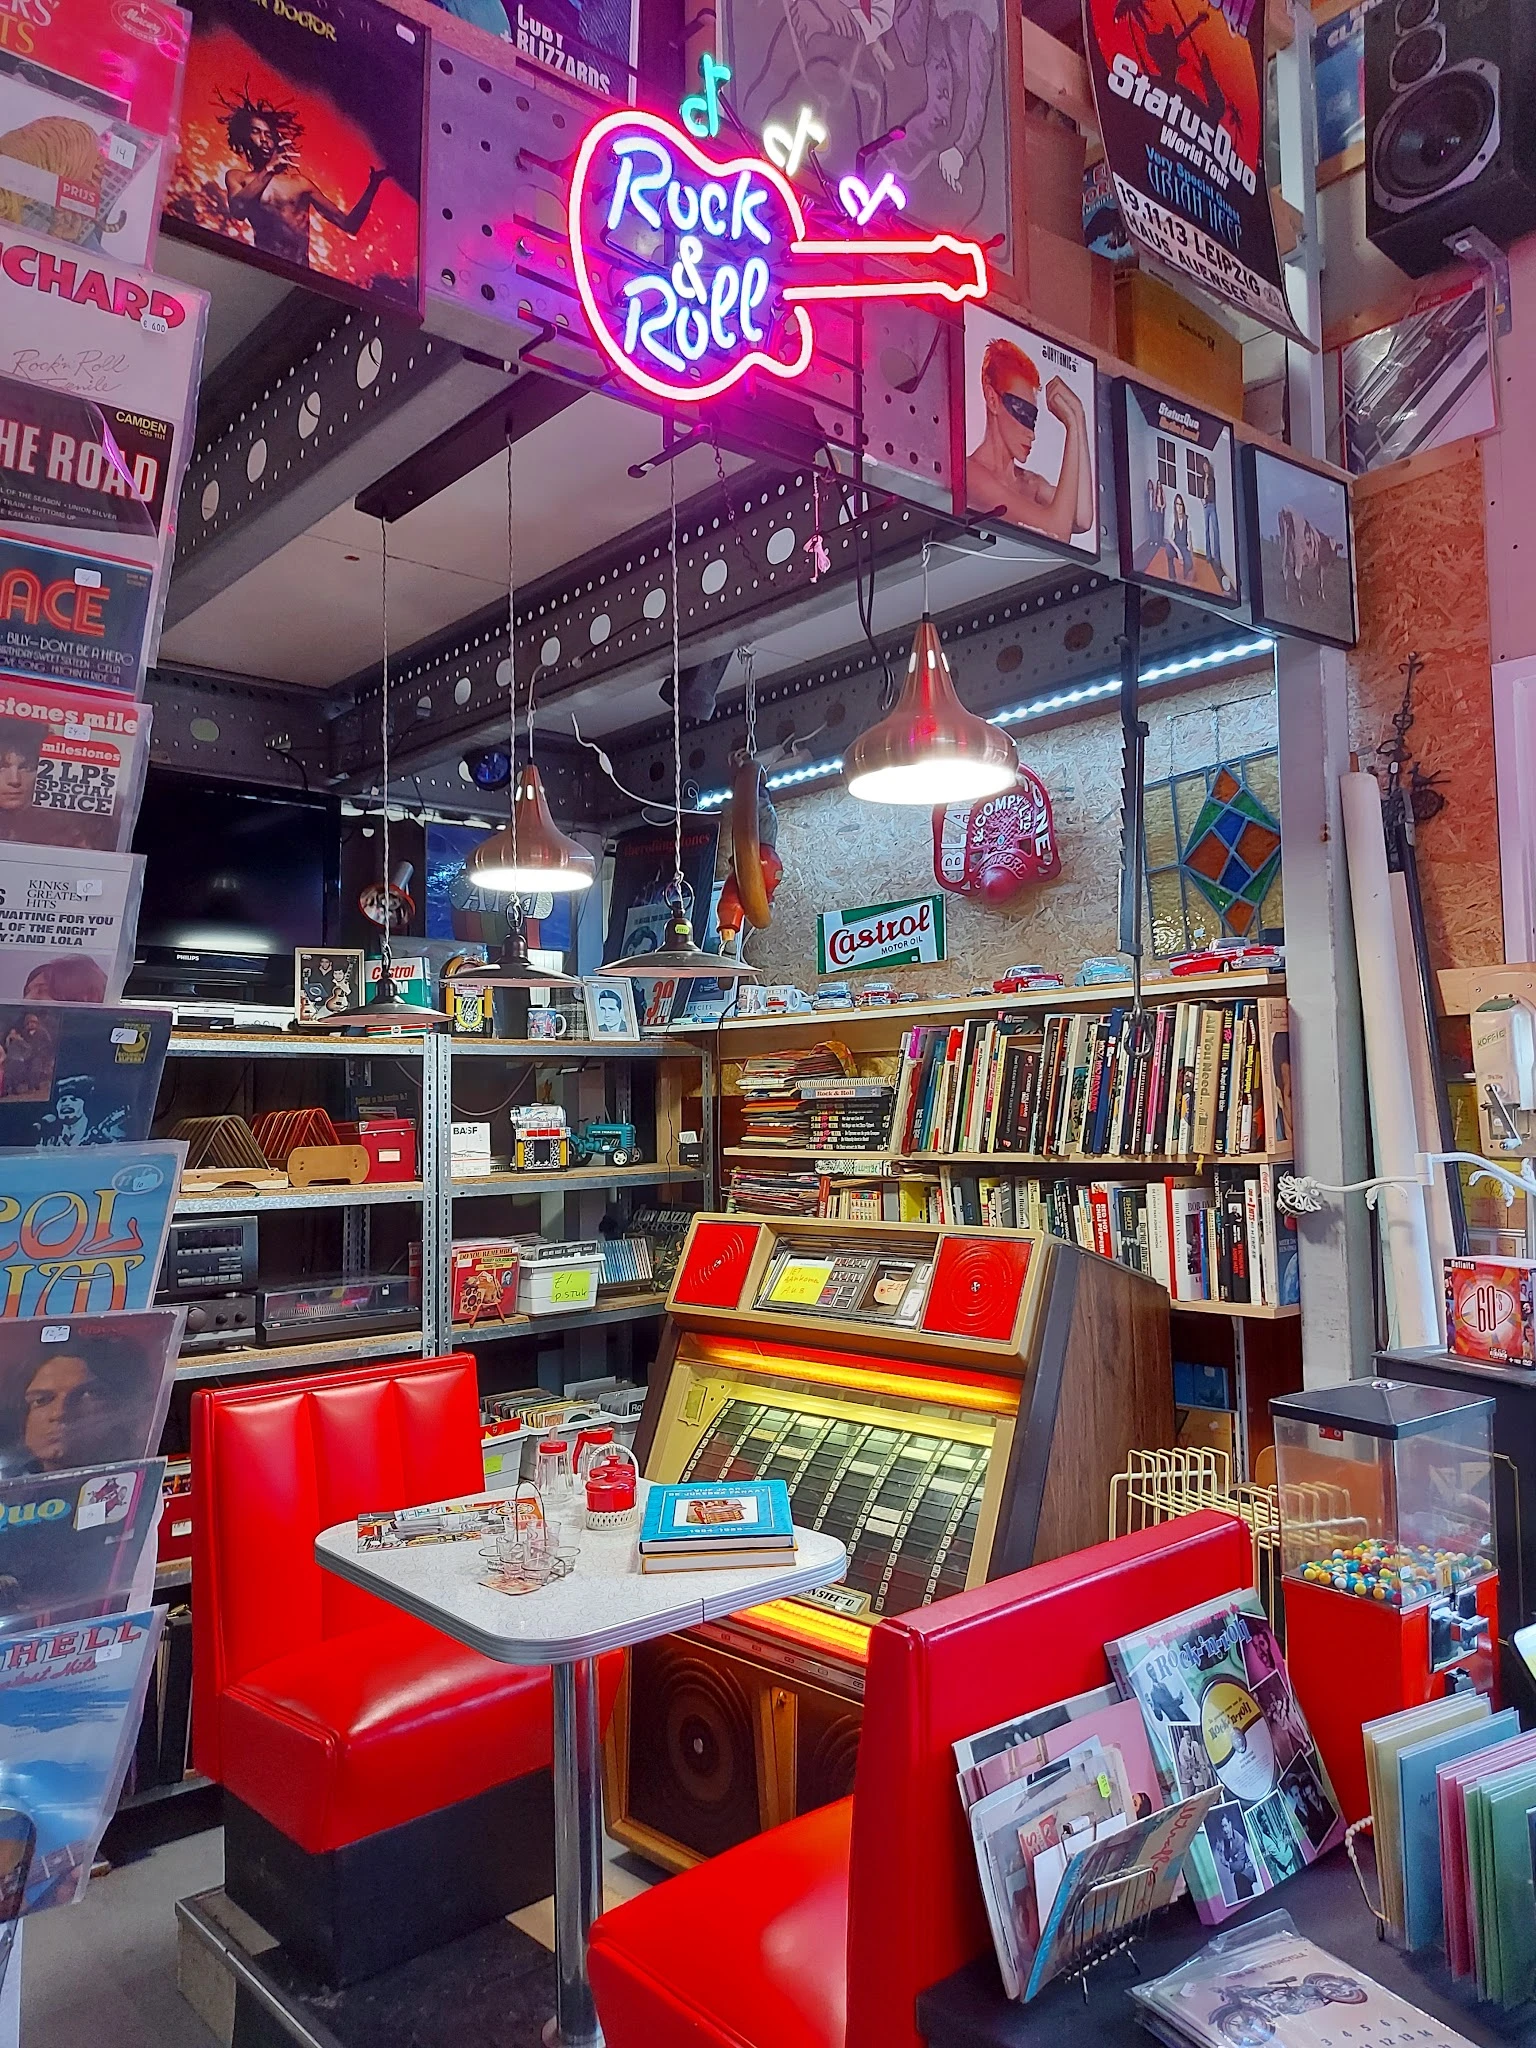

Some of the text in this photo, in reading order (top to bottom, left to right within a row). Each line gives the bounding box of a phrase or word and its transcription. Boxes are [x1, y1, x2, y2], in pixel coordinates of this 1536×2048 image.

[516, 30, 612, 95] BLIZZARDS
[1160, 125, 1230, 190] World Tour
[1145, 144, 1173, 175] Very
[1176, 161, 1214, 201] Special
[62, 182, 97, 204] PRIJS
[606, 136, 771, 246] Rock
[1126, 210, 1173, 257] HAUS
[671, 234, 707, 306] &
[1194, 232, 1261, 297] LEIPZIG
[0, 242, 187, 330] CHARD
[622, 255, 771, 373] Roll
[73, 349, 129, 380] Roll
[115, 411, 167, 434] CAMDEN
[47, 432, 158, 503] ROAD
[3, 499, 26, 510] TRAIN
[18, 492, 31, 501] THE
[33, 494, 61, 508] SEASON
[42, 742, 122, 762] milestones
[37, 759, 116, 788] 2 LP's
[36, 779, 113, 800] SPECIAL
[33, 790, 113, 815] PRICE
[29, 879, 70, 892] KINKS
[26, 898, 57, 909] HITS
[8, 922, 98, 937] OF THE NIGHT
[58, 914, 85, 925] FOR
[88, 915, 114, 926] YOU
[16, 934, 83, 946] AND LOLA
[829, 904, 930, 965] Castrol
[881, 936, 924, 955] MOTOR OIL
[372, 965, 415, 980] Cstrol
[1205, 1014, 1216, 1034] All
[1202, 1035, 1214, 1061] You
[1477, 1029, 1505, 1048] KOFFIE
[453, 1126, 478, 1136] BASF
[1095, 1203, 1105, 1254] CHILI PEPPERS
[1100, 1203, 1109, 1234] RED HOT
[1342, 2030, 1353, 2040] 4
[1361, 2023, 1372, 2032] 5
[1397, 2033, 1416, 2042] 13
[1416, 2029, 1434, 2038] 14
